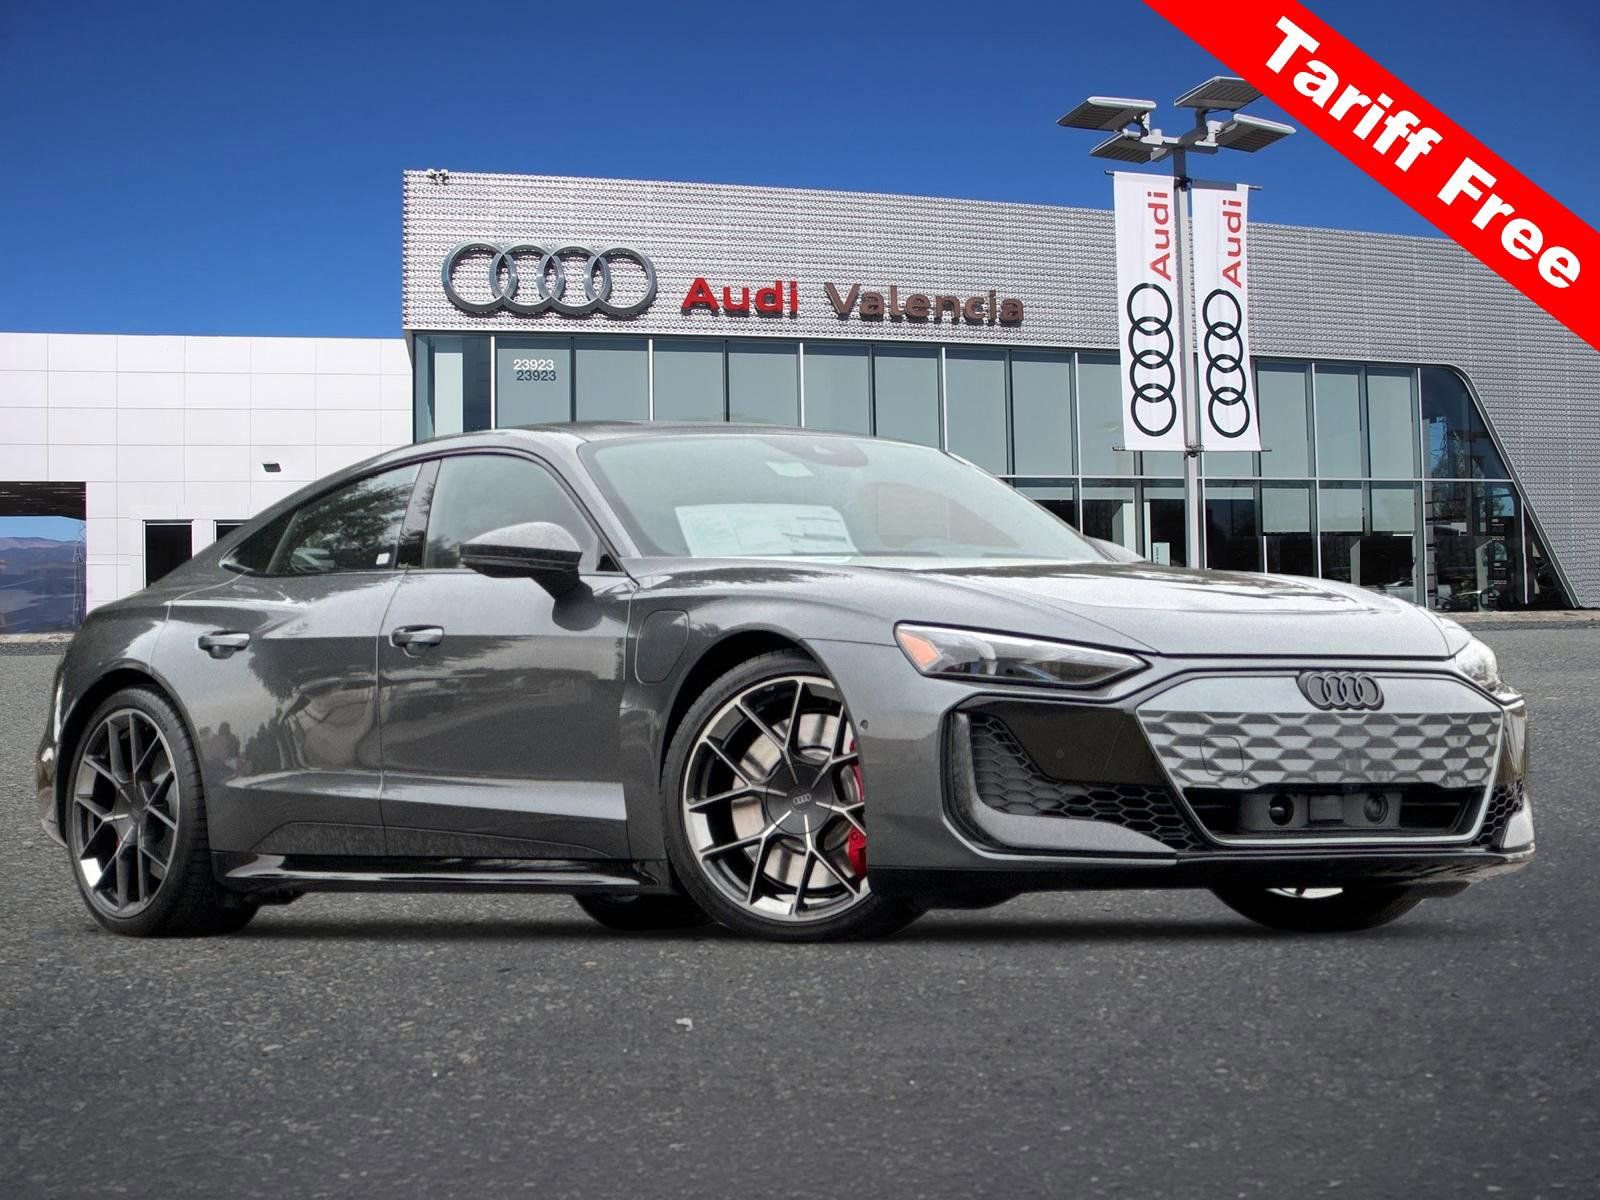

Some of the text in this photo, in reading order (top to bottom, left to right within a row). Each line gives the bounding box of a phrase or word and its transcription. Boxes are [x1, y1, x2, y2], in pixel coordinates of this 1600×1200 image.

[1147, 191, 1172, 281] Audi
[1222, 199, 1242, 288] Audi
[681, 277, 1024, 325] Audi Valencia
[513, 359, 554, 370] 23923
[516, 370, 556, 381] 23923
